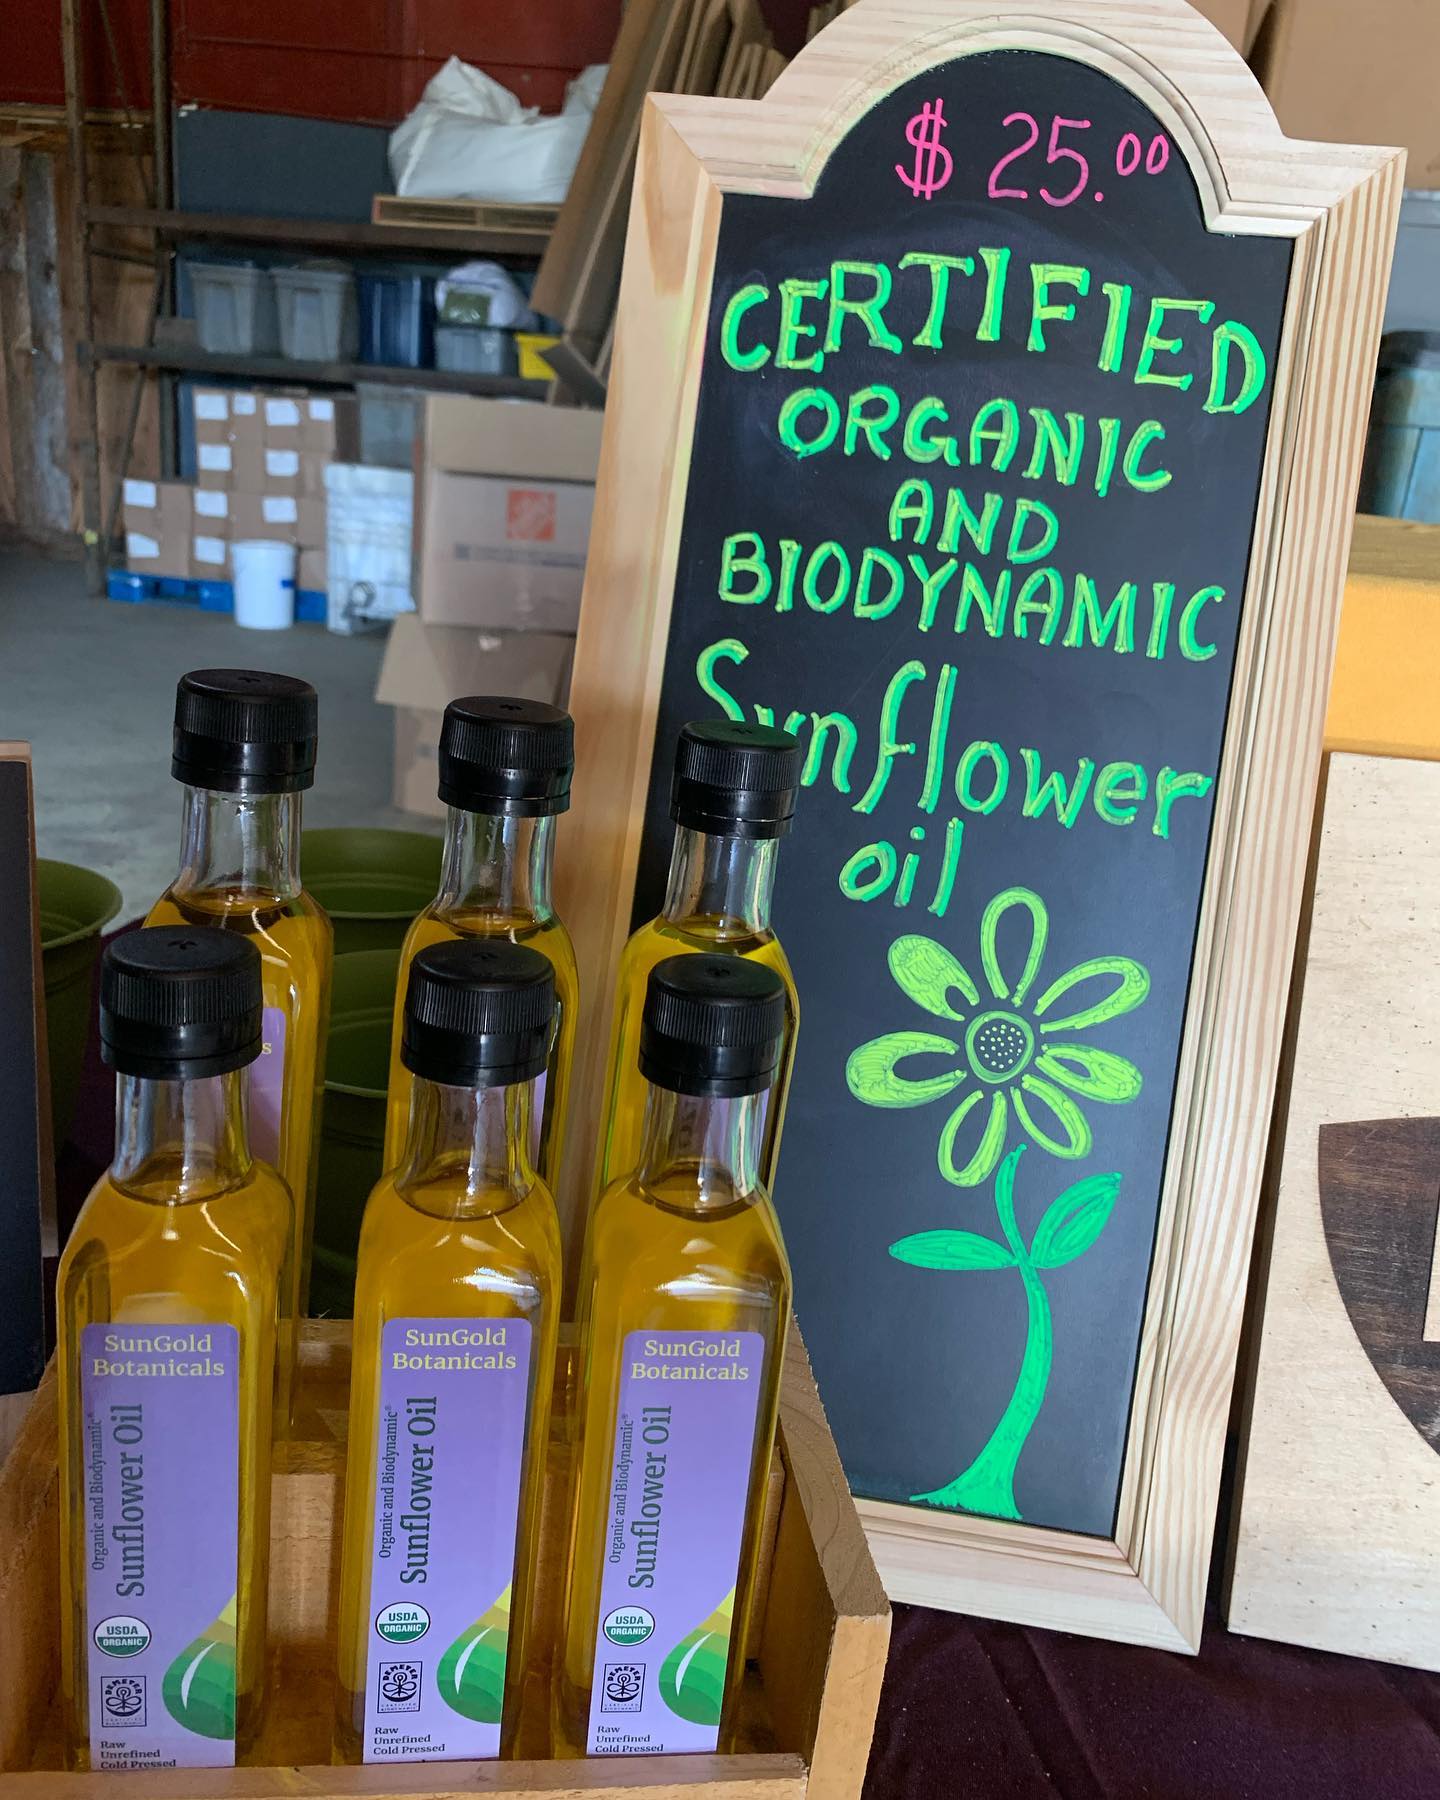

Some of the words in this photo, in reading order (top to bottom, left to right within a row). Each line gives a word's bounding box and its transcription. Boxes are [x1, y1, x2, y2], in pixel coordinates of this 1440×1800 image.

[895, 98, 953, 199] $
[720, 247, 1267, 414] CERTIFIED
[777, 383, 1172, 497] ORGANIC
[888, 479, 1059, 564] AND
[718, 532, 1226, 662] BIODYNAMIC
[839, 817, 964, 917] oil
[104, 1333, 212, 1353] SunGold
[405, 1327, 507, 1346] SunGold
[644, 1339, 741, 1357] SunGold
[93, 1358, 225, 1376] Botanicals
[392, 1352, 517, 1370] Botanicals
[631, 1363, 749, 1380] Botanicals
[110, 1403, 143, 1445] Oil
[406, 1396, 437, 1436] Oil
[642, 1405, 672, 1445] Oil
[381, 1487, 394, 1509] and
[614, 1494, 627, 1516] and
[89, 1497, 104, 1519] and
[400, 1443, 434, 1584] Sunflower
[112, 1452, 145, 1597] Sunflower
[628, 1451, 667, 1588] Sunflower
[379, 1511, 396, 1558] Organic
[609, 1518, 626, 1563] Organic
[90, 1522, 109, 1570] Organic
[388, 1612, 418, 1621] USDA
[615, 1616, 644, 1625] USDA
[106, 1625, 138, 1635] USDA
[384, 1624, 422, 1633] ORGANIC
[611, 1627, 647, 1636] ORGANIC
[103, 1638, 143, 1647] ORGANIC
[607, 1666, 641, 1682] DEMETER
[375, 1726, 399, 1735] Raw
[597, 1725, 620, 1733] Raw
[100, 1740, 126, 1749] Raw
[374, 1735, 431, 1745] Unrefined
[596, 1734, 651, 1743] Unrefined
[100, 1749, 161, 1759] Unrefined
[373, 1746, 399, 1755] Cold
[402, 1744, 445, 1754] Pressed
[595, 1744, 620, 1753] Cold
[622, 1743, 664, 1752] Pressed
[100, 1760, 128, 1770] Cold
[131, 1759, 176, 1768] Pressed
